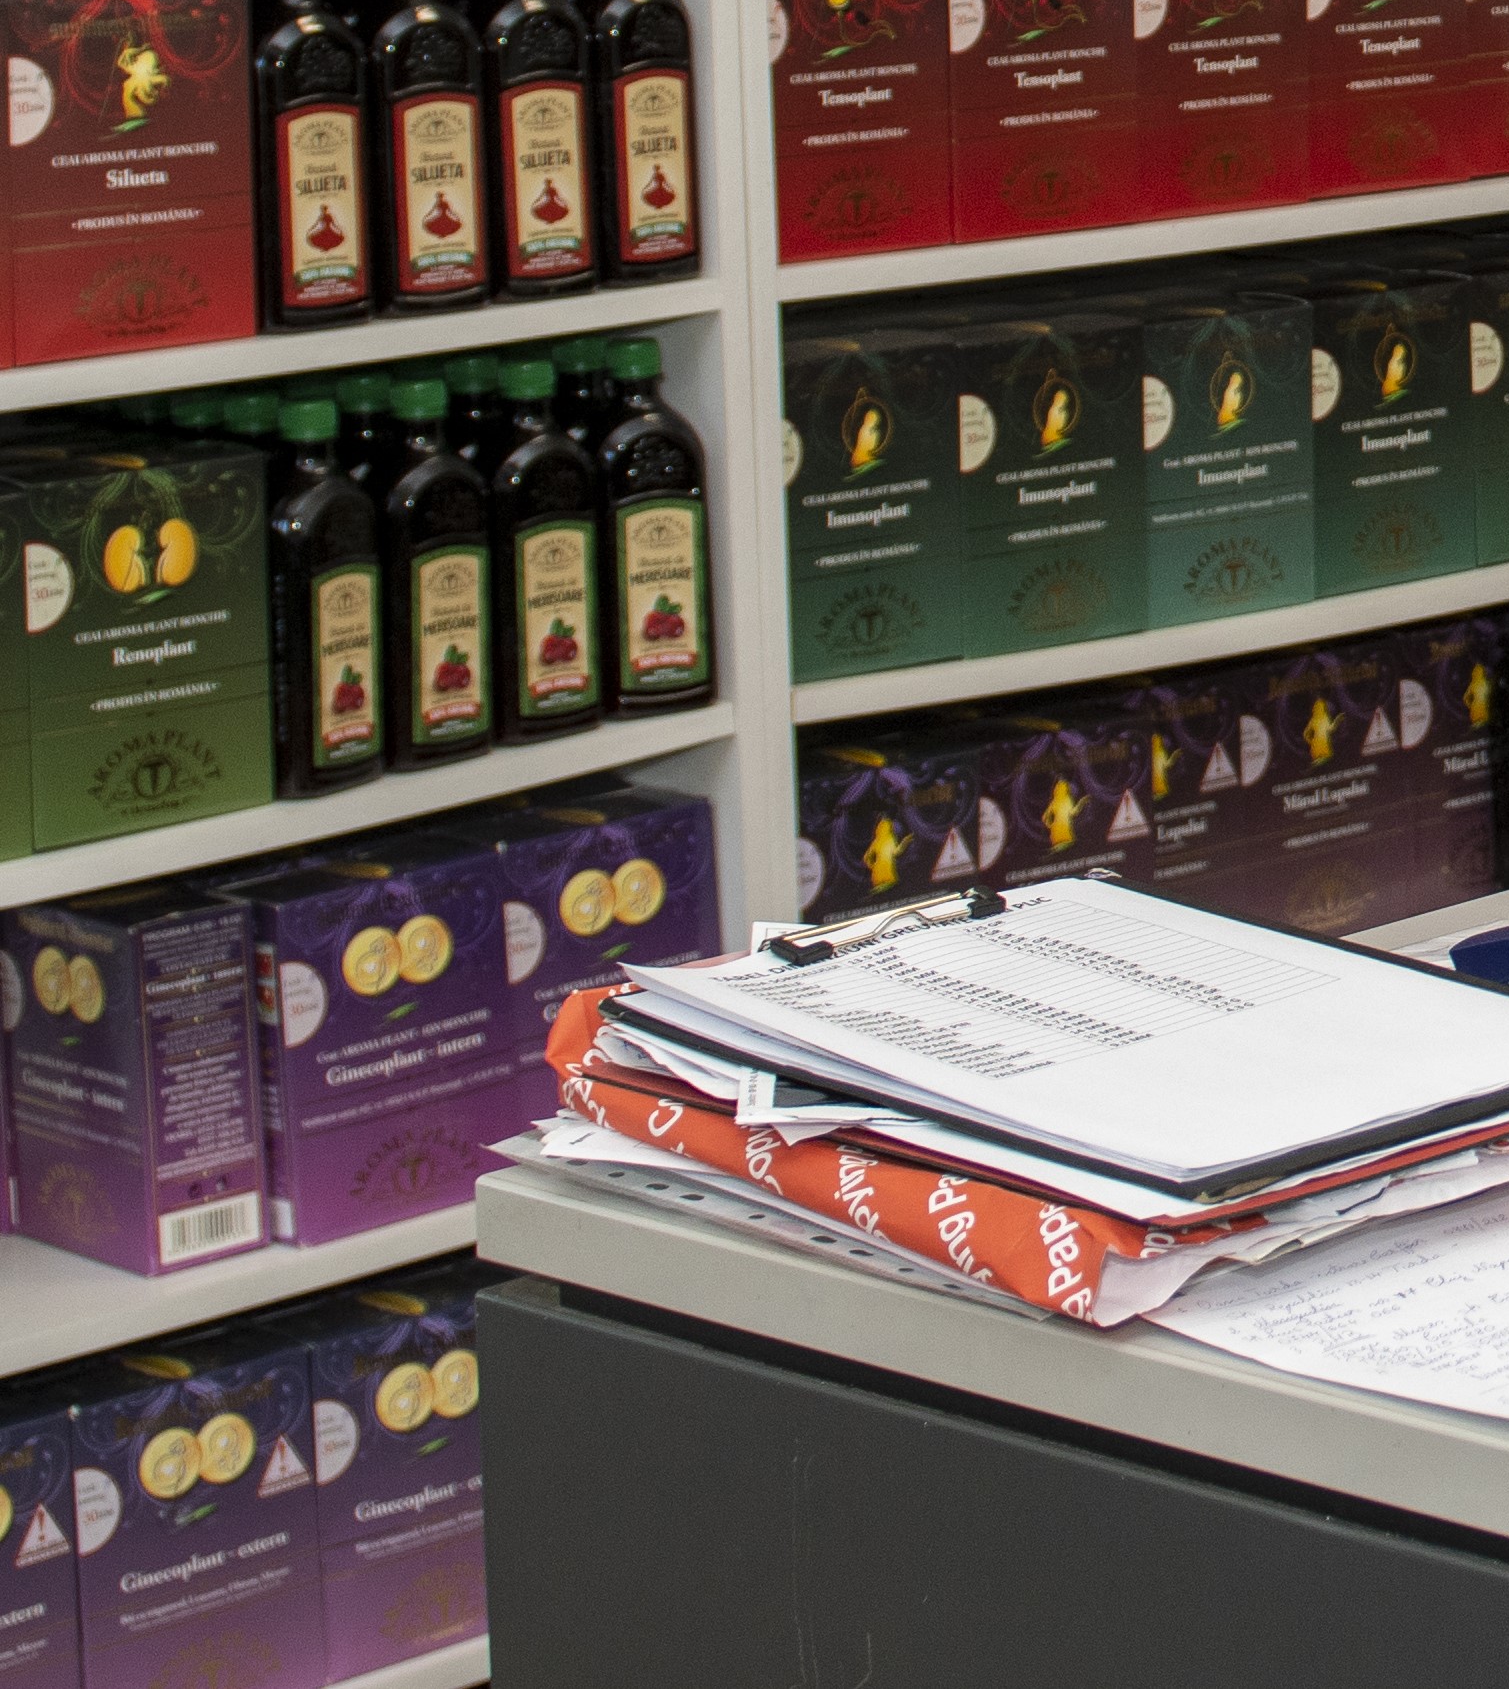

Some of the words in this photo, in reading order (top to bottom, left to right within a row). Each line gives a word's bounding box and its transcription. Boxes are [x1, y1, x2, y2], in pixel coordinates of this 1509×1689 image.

[1359, 35, 1420, 55] Tensoplant
[1193, 54, 1259, 75] Tensoplant
[1014, 68, 1083, 90] Tensoplant
[818, 86, 892, 108] Tensoplant
[630, 136, 679, 156] SILUETA
[51, 153, 78, 168] CEAI
[122, 148, 161, 163] PLANT
[519, 150, 572, 170] SILUETA
[106, 168, 168, 188] Silueta
[411, 162, 465, 184] SILUETA
[295, 176, 347, 198] SILUETA
[78, 215, 120, 231] PRODUS
[1360, 429, 1431, 452] Imunoplant
[1198, 464, 1269, 485] Imunoplant
[1018, 481, 1096, 506] Imunoplant
[827, 502, 911, 529] Imunoplant
[113, 640, 194, 668] Renoplant
[1014, 895, 1052, 911] PLIC
[325, 1051, 426, 1086] Ginecoplant
[438, 1032, 484, 1058] intern
[354, 1484, 457, 1522] Ginecoplant
[120, 1549, 227, 1593] Ginecoplant
[238, 1530, 289, 1560] extern
[0, 1602, 45, 1629] xtern
